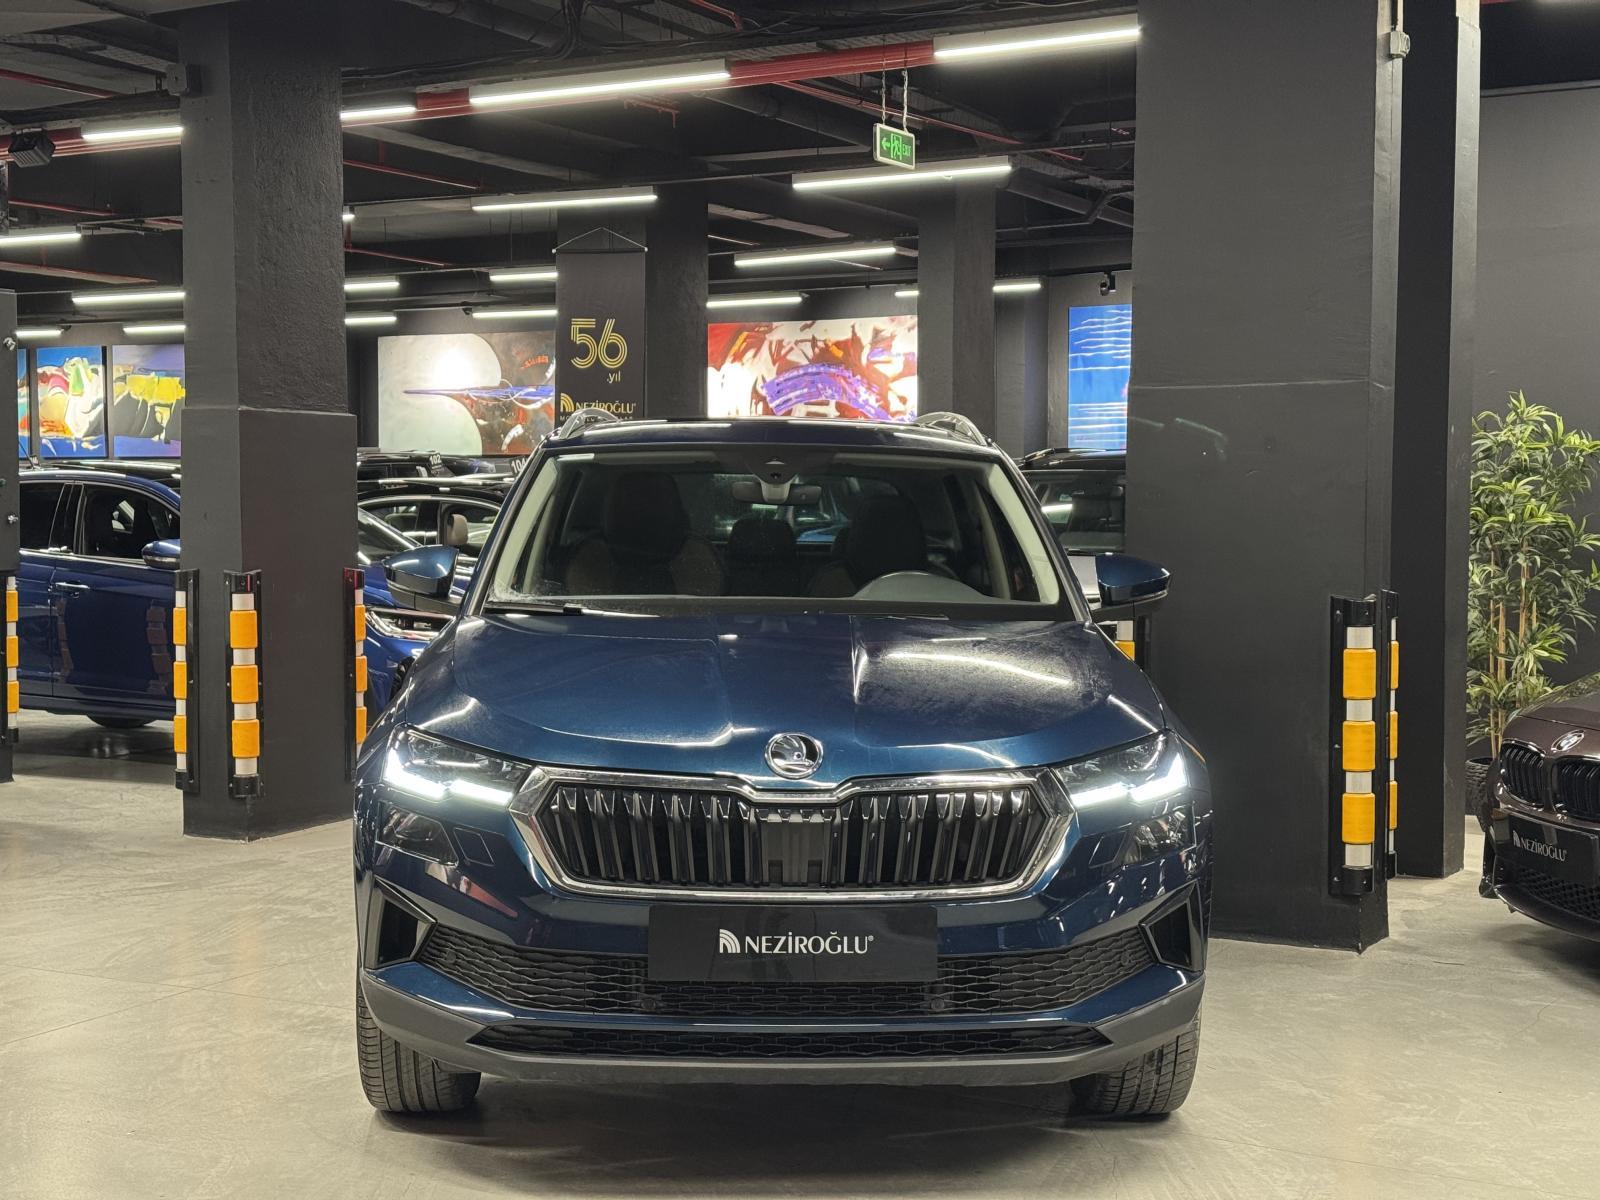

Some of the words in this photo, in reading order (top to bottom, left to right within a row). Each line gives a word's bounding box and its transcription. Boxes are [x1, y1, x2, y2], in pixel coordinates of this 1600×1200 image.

[571, 318, 628, 368] 56
[429, 454, 442, 465] 102
[1520, 837, 1566, 862] NEZİROĞLU
[745, 931, 868, 954] NEZİROĞLU
